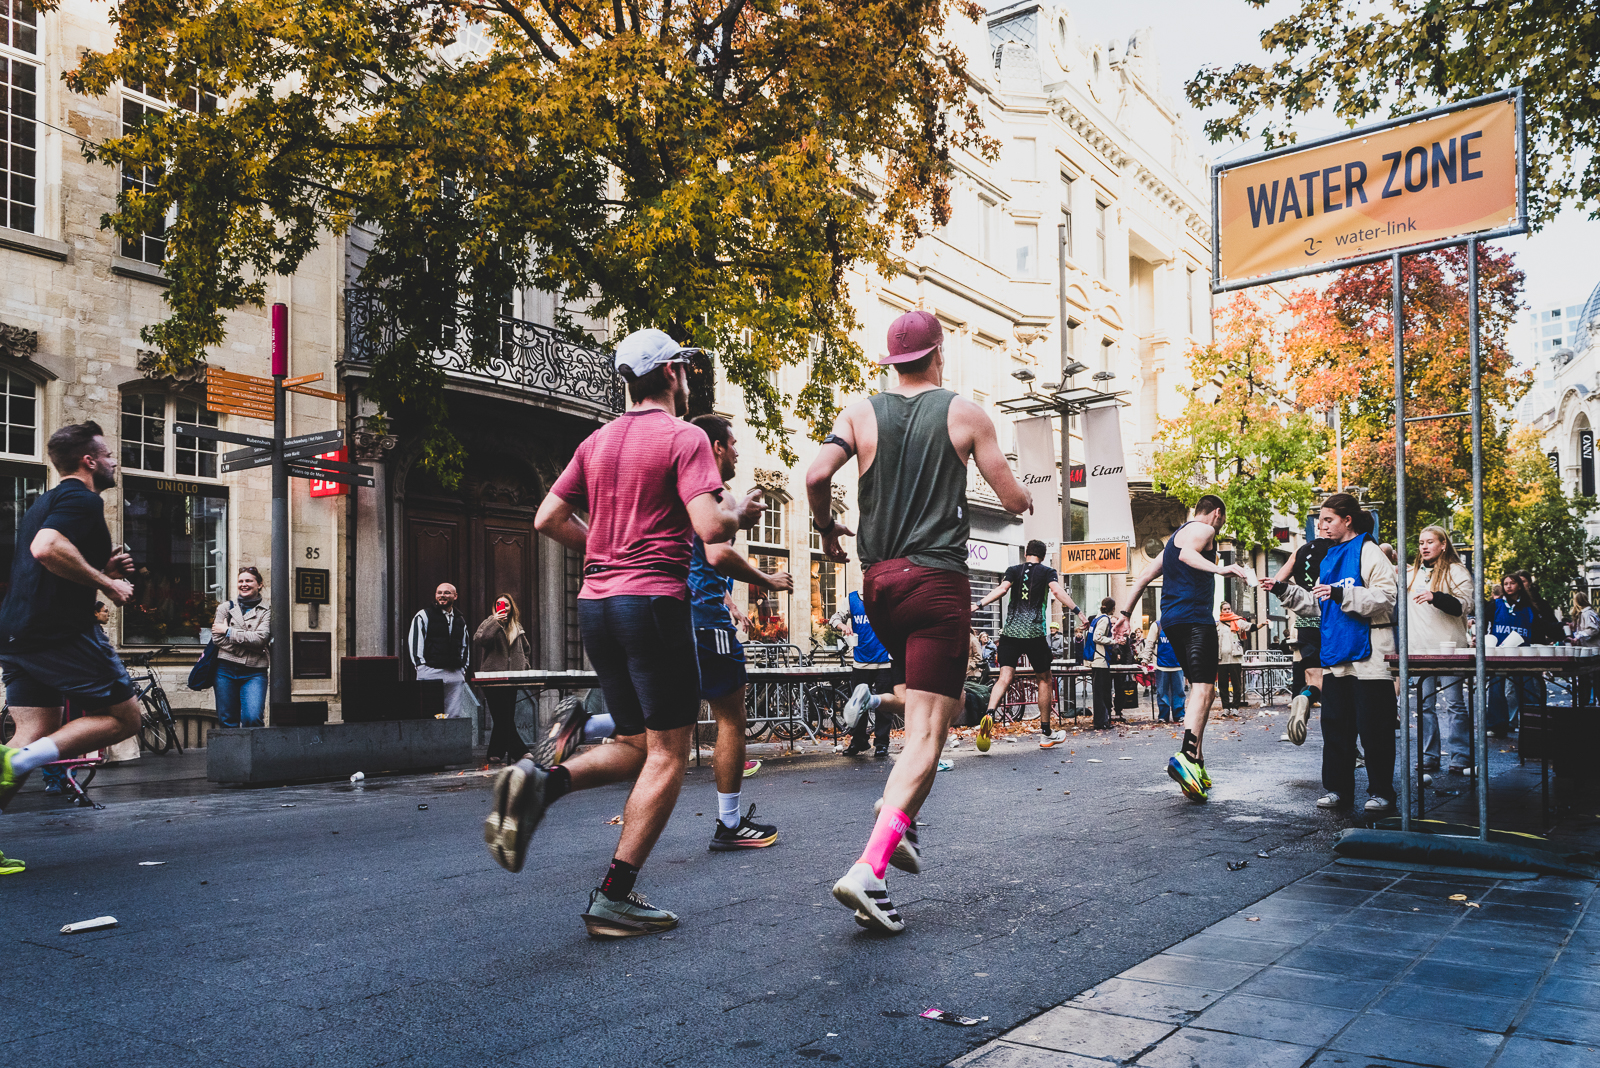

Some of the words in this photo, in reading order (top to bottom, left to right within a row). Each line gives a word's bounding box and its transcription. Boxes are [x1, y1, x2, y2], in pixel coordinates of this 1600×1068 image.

[1247, 160, 1368, 229] WATER
[1381, 130, 1483, 199] ZONE
[1335, 216, 1417, 246] water-link
[246, 437, 271, 445] Rubenshuis
[1091, 464, 1123, 477] Etam
[1022, 473, 1052, 485] Etam
[157, 480, 198, 494] UNIQLO
[305, 546, 320, 560] 85
[1068, 549, 1096, 561] WATER
[1098, 548, 1121, 560] ZONE
